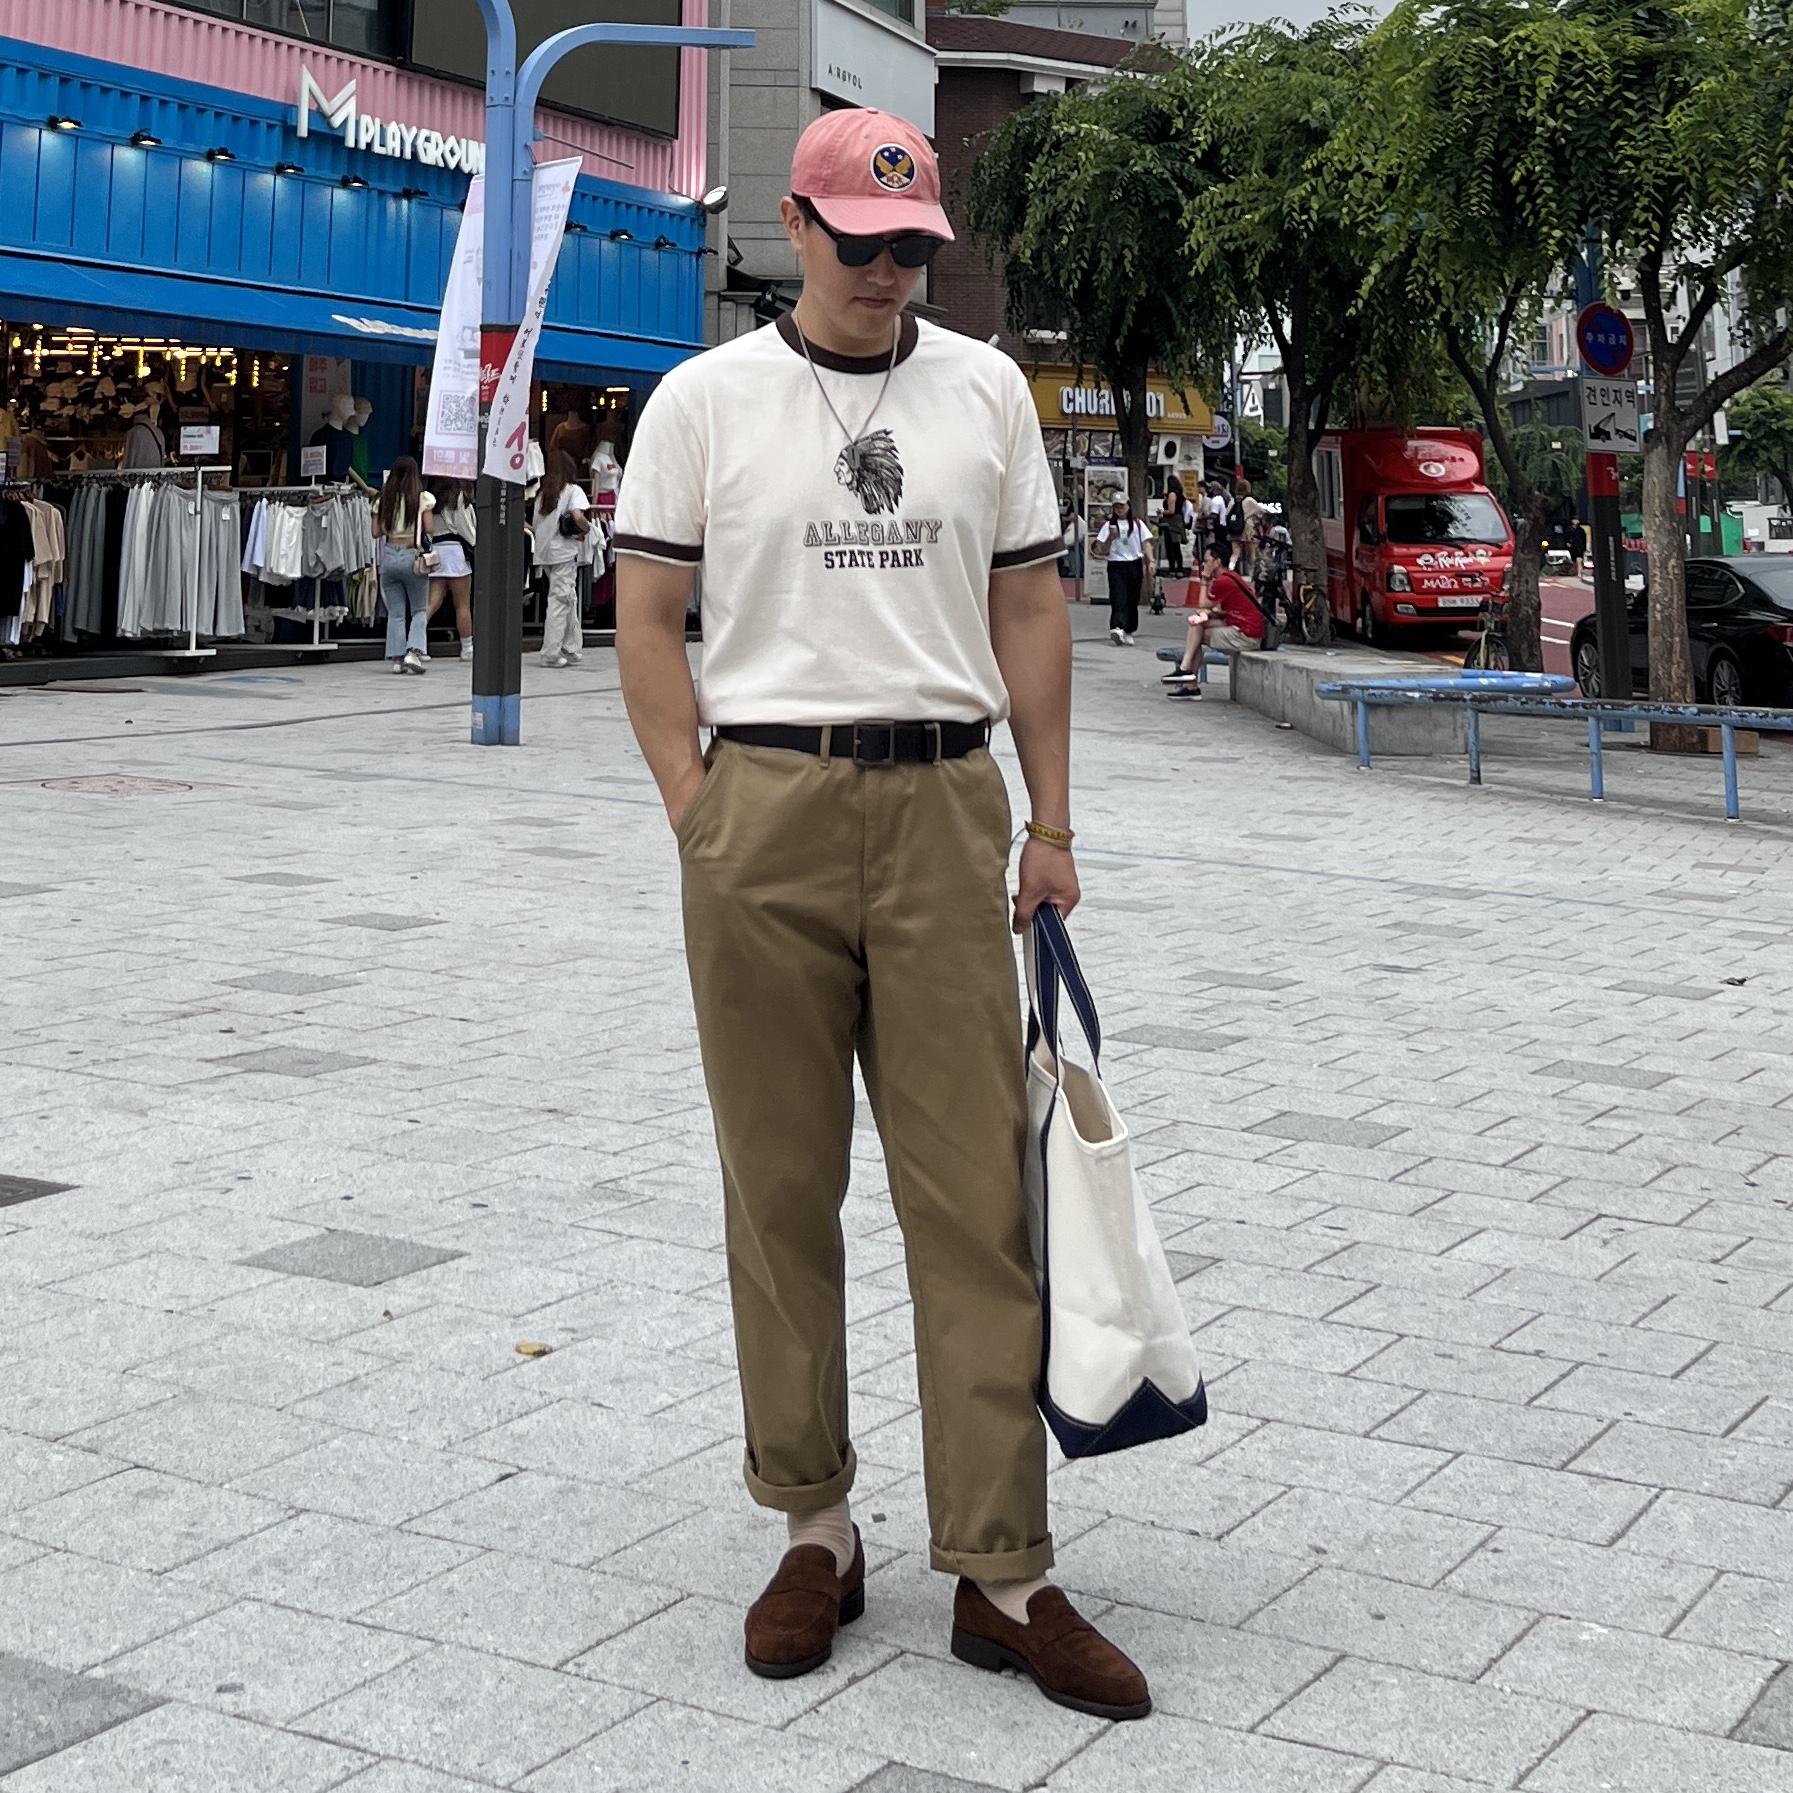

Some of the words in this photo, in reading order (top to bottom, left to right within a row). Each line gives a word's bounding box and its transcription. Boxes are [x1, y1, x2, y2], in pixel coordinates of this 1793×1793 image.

[357, 114, 486, 174] PLAYGROUN
[1586, 386, 1636, 409] 견인지역
[803, 519, 943, 547] ALLEGANY
[824, 549, 875, 569] STATE
[879, 549, 924, 568] PARK
